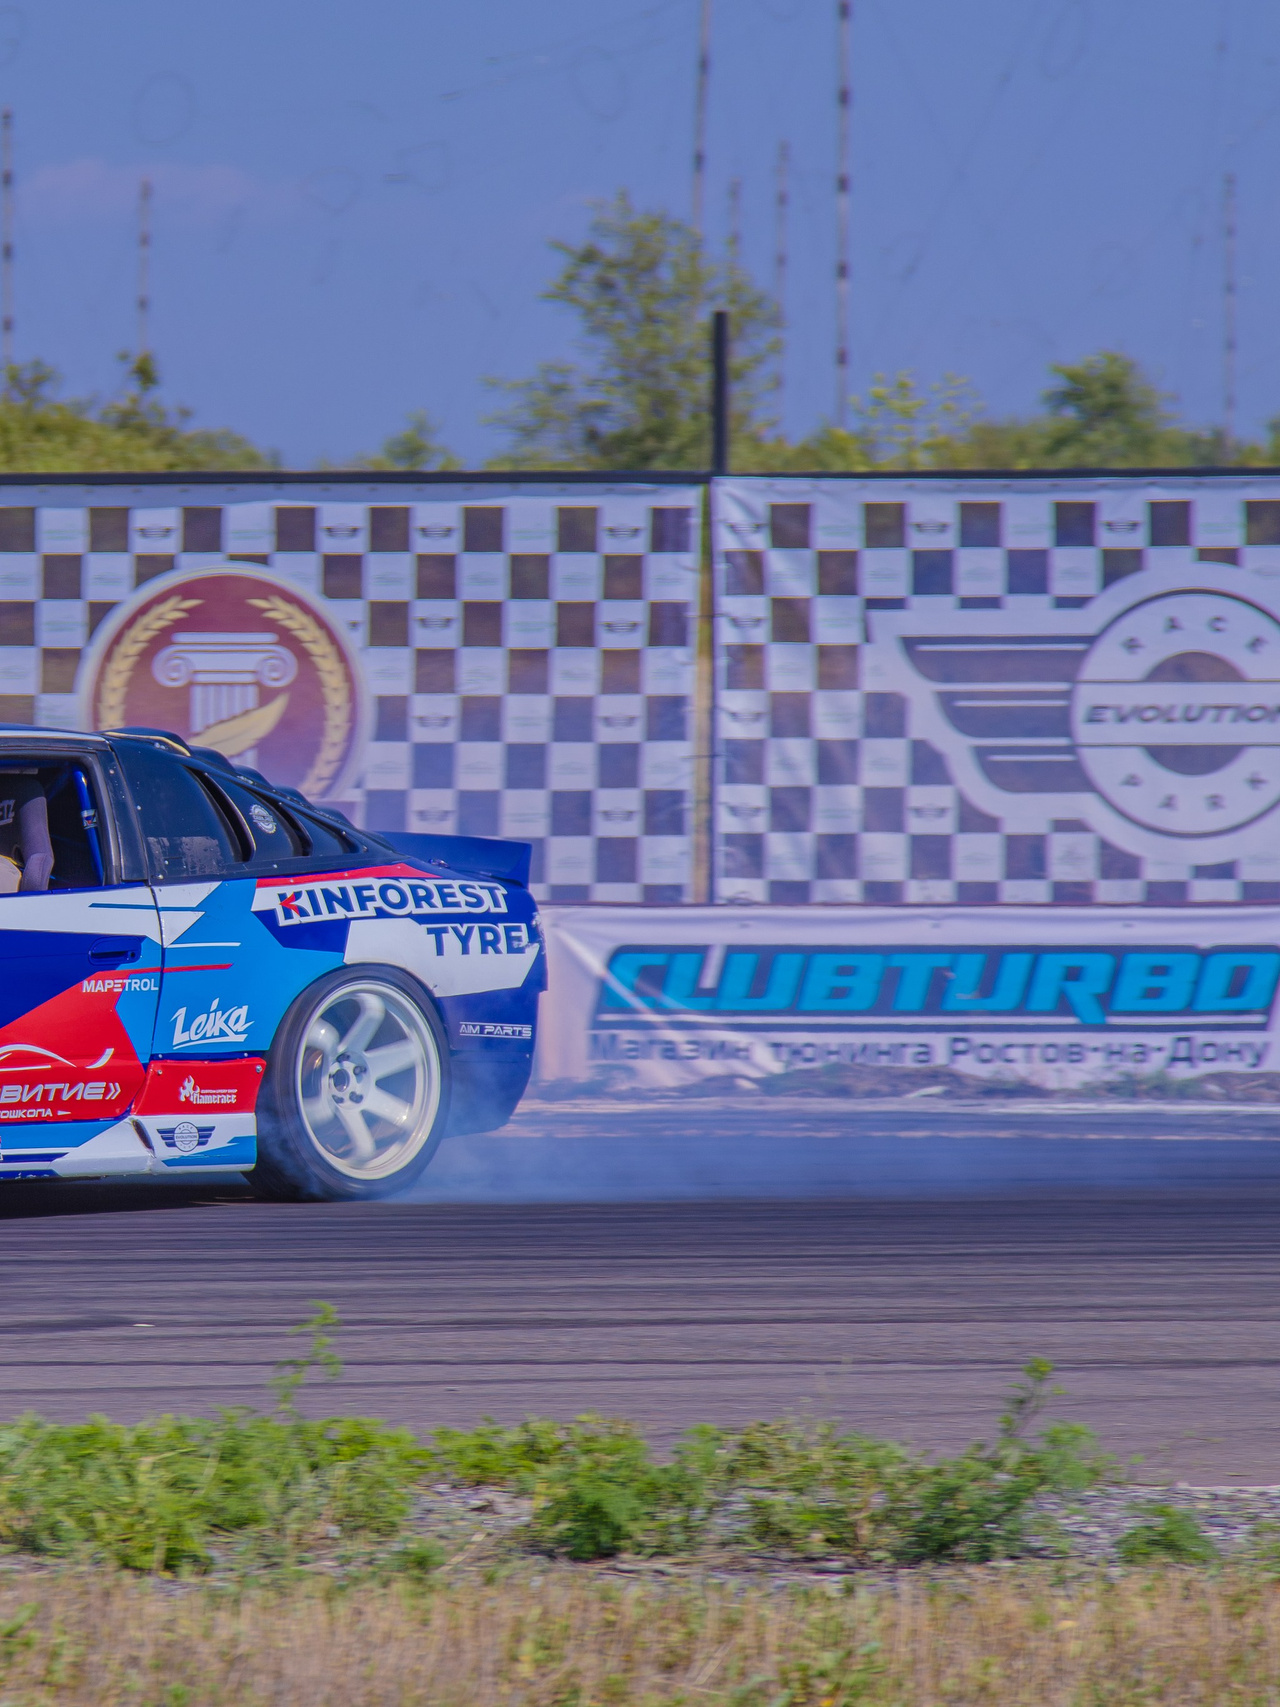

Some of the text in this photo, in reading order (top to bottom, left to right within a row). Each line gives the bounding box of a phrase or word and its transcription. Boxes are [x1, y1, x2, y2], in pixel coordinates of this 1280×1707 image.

[278, 883, 507, 921] KINFOREST
[426, 924, 529, 956] TYRE
[82, 979, 159, 993] MAPETROL
[605, 953, 1280, 1024] CLUBTURBO
[484, 1025, 532, 1037] PARTS
